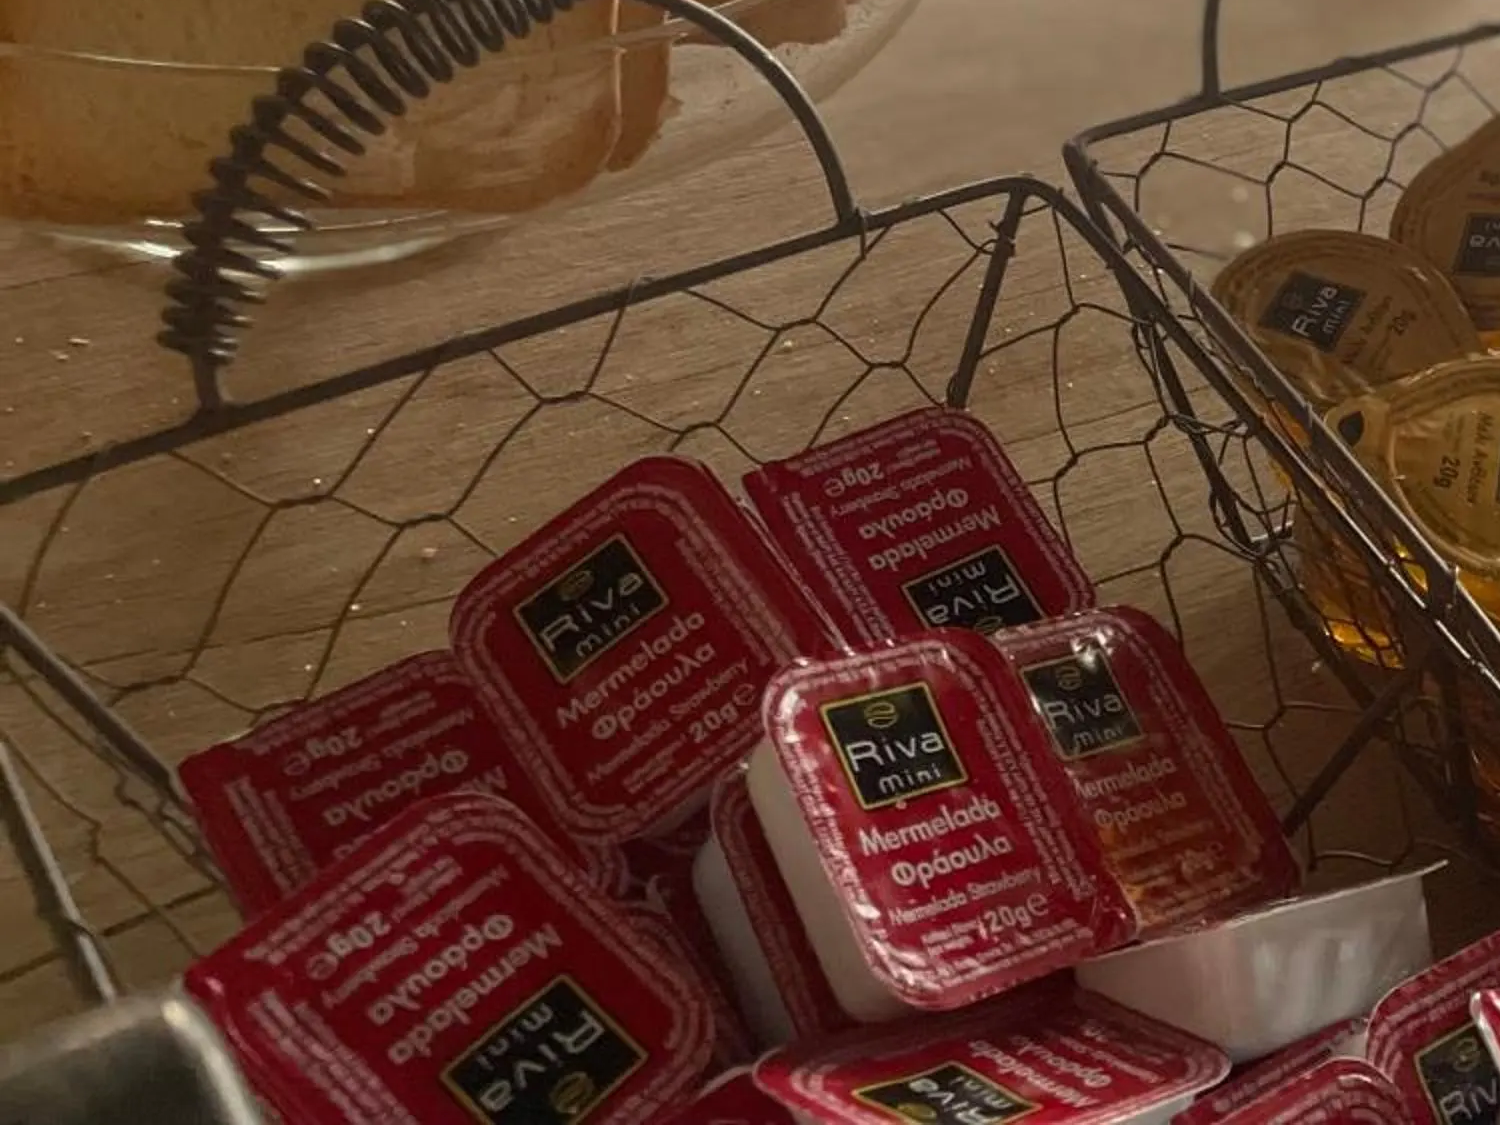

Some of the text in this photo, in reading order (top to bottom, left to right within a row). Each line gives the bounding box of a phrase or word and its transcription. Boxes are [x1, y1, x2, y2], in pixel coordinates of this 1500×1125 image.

[1290, 285, 1339, 337] Riva
[1432, 454, 1461, 488] 20g
[857, 488, 969, 540] Φράουλα
[867, 503, 1003, 572] Mermelada
[926, 573, 1021, 625] Riva
[928, 560, 987, 596] mini
[540, 571, 645, 653] Riva
[575, 602, 641, 658] mini
[556, 611, 705, 729] Mermelada
[591, 642, 716, 740] Φράουλα
[1043, 693, 1122, 731] Riva
[1072, 726, 1125, 751] mini
[844, 730, 945, 773] Riva
[878, 762, 942, 795] mini
[322, 749, 470, 826] Φράουλα
[858, 794, 1002, 857] Mermelada
[889, 833, 1013, 890] Φράουλα
[368, 913, 515, 1026] Φράουλα
[388, 922, 564, 1065] Mermelada
[476, 1001, 554, 1071] mini
[479, 1009, 605, 1113] Riva
[908, 1077, 992, 1125] Riva
[948, 1075, 1014, 1110] mini
